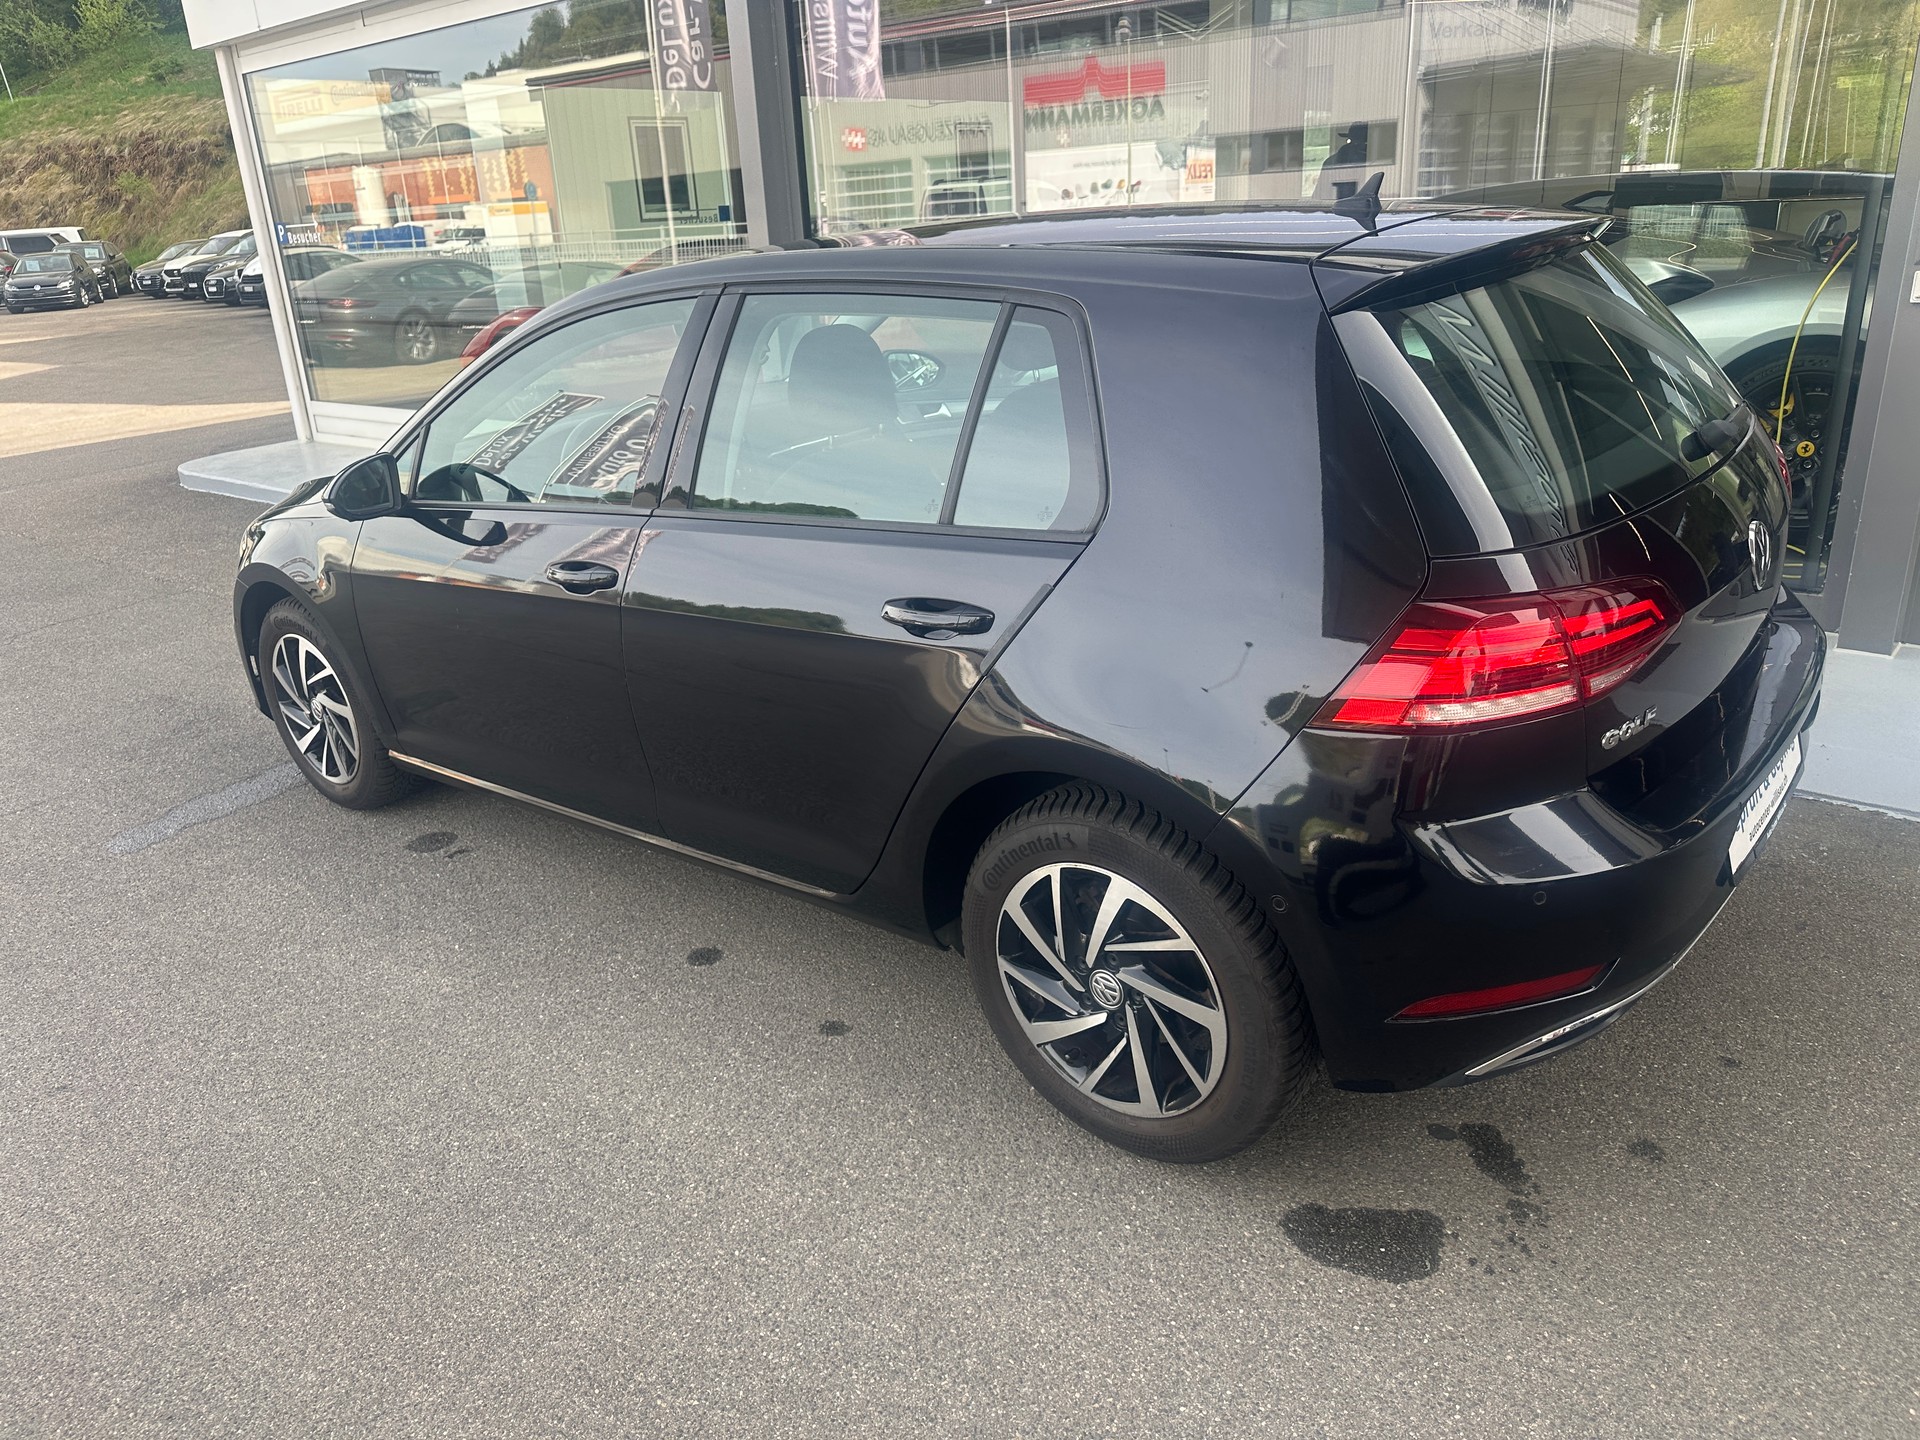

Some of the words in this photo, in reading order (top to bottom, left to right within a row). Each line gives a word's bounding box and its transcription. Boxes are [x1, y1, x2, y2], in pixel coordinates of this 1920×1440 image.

[277, 225, 285, 242] P
[287, 230, 321, 245] Besucher
[1601, 704, 1657, 750] GOLF
[982, 832, 1062, 891] Continental
